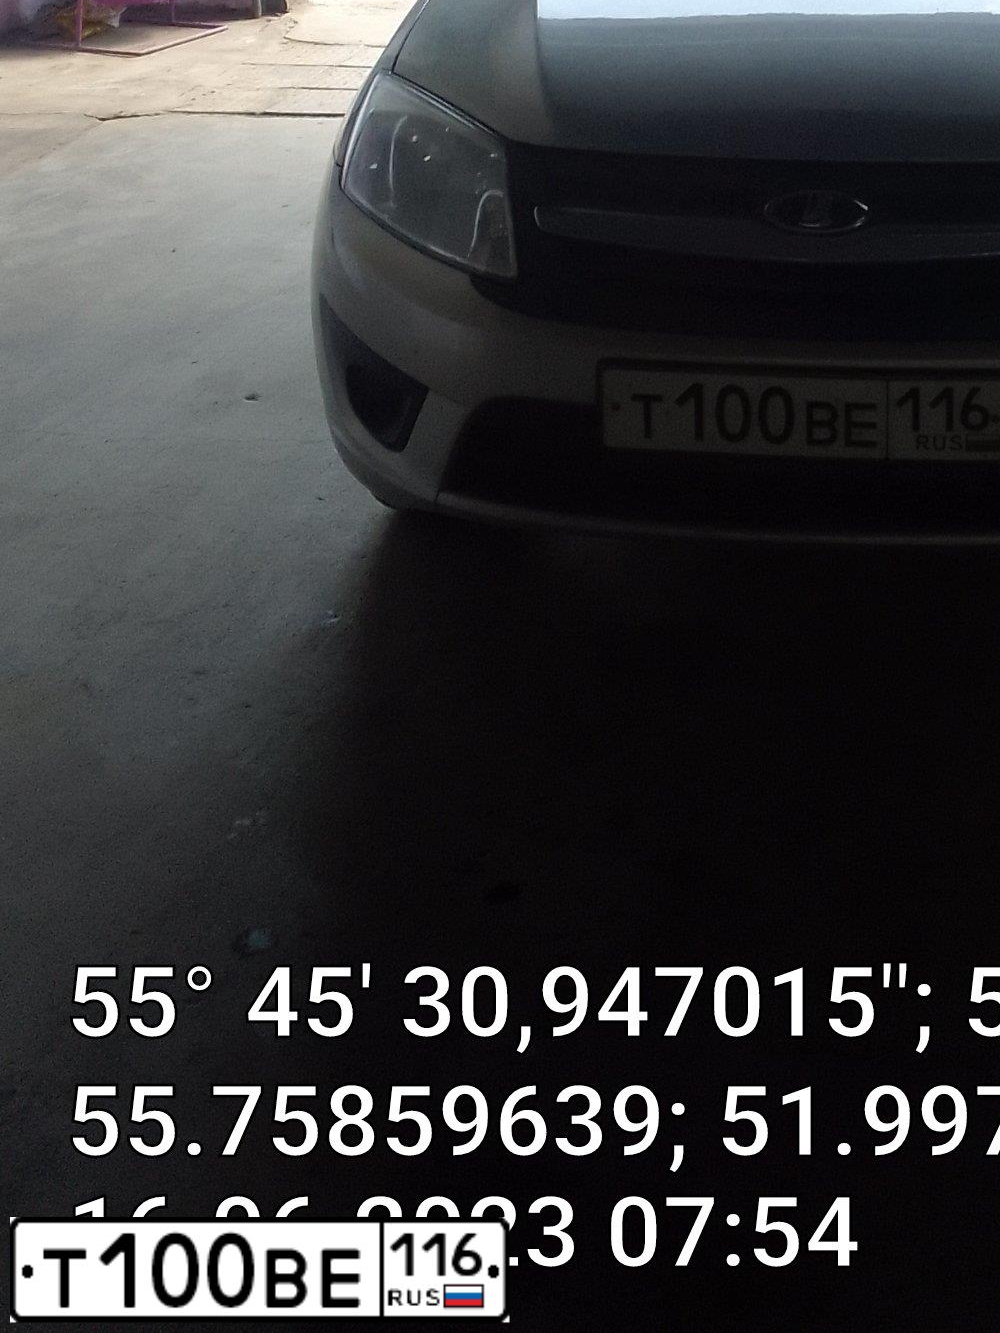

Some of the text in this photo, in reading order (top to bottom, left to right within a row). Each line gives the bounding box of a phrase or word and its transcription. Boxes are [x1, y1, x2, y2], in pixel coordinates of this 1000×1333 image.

[630, 383, 989, 447] Т100ВЕ 116
[916, 435, 963, 452] RUS
